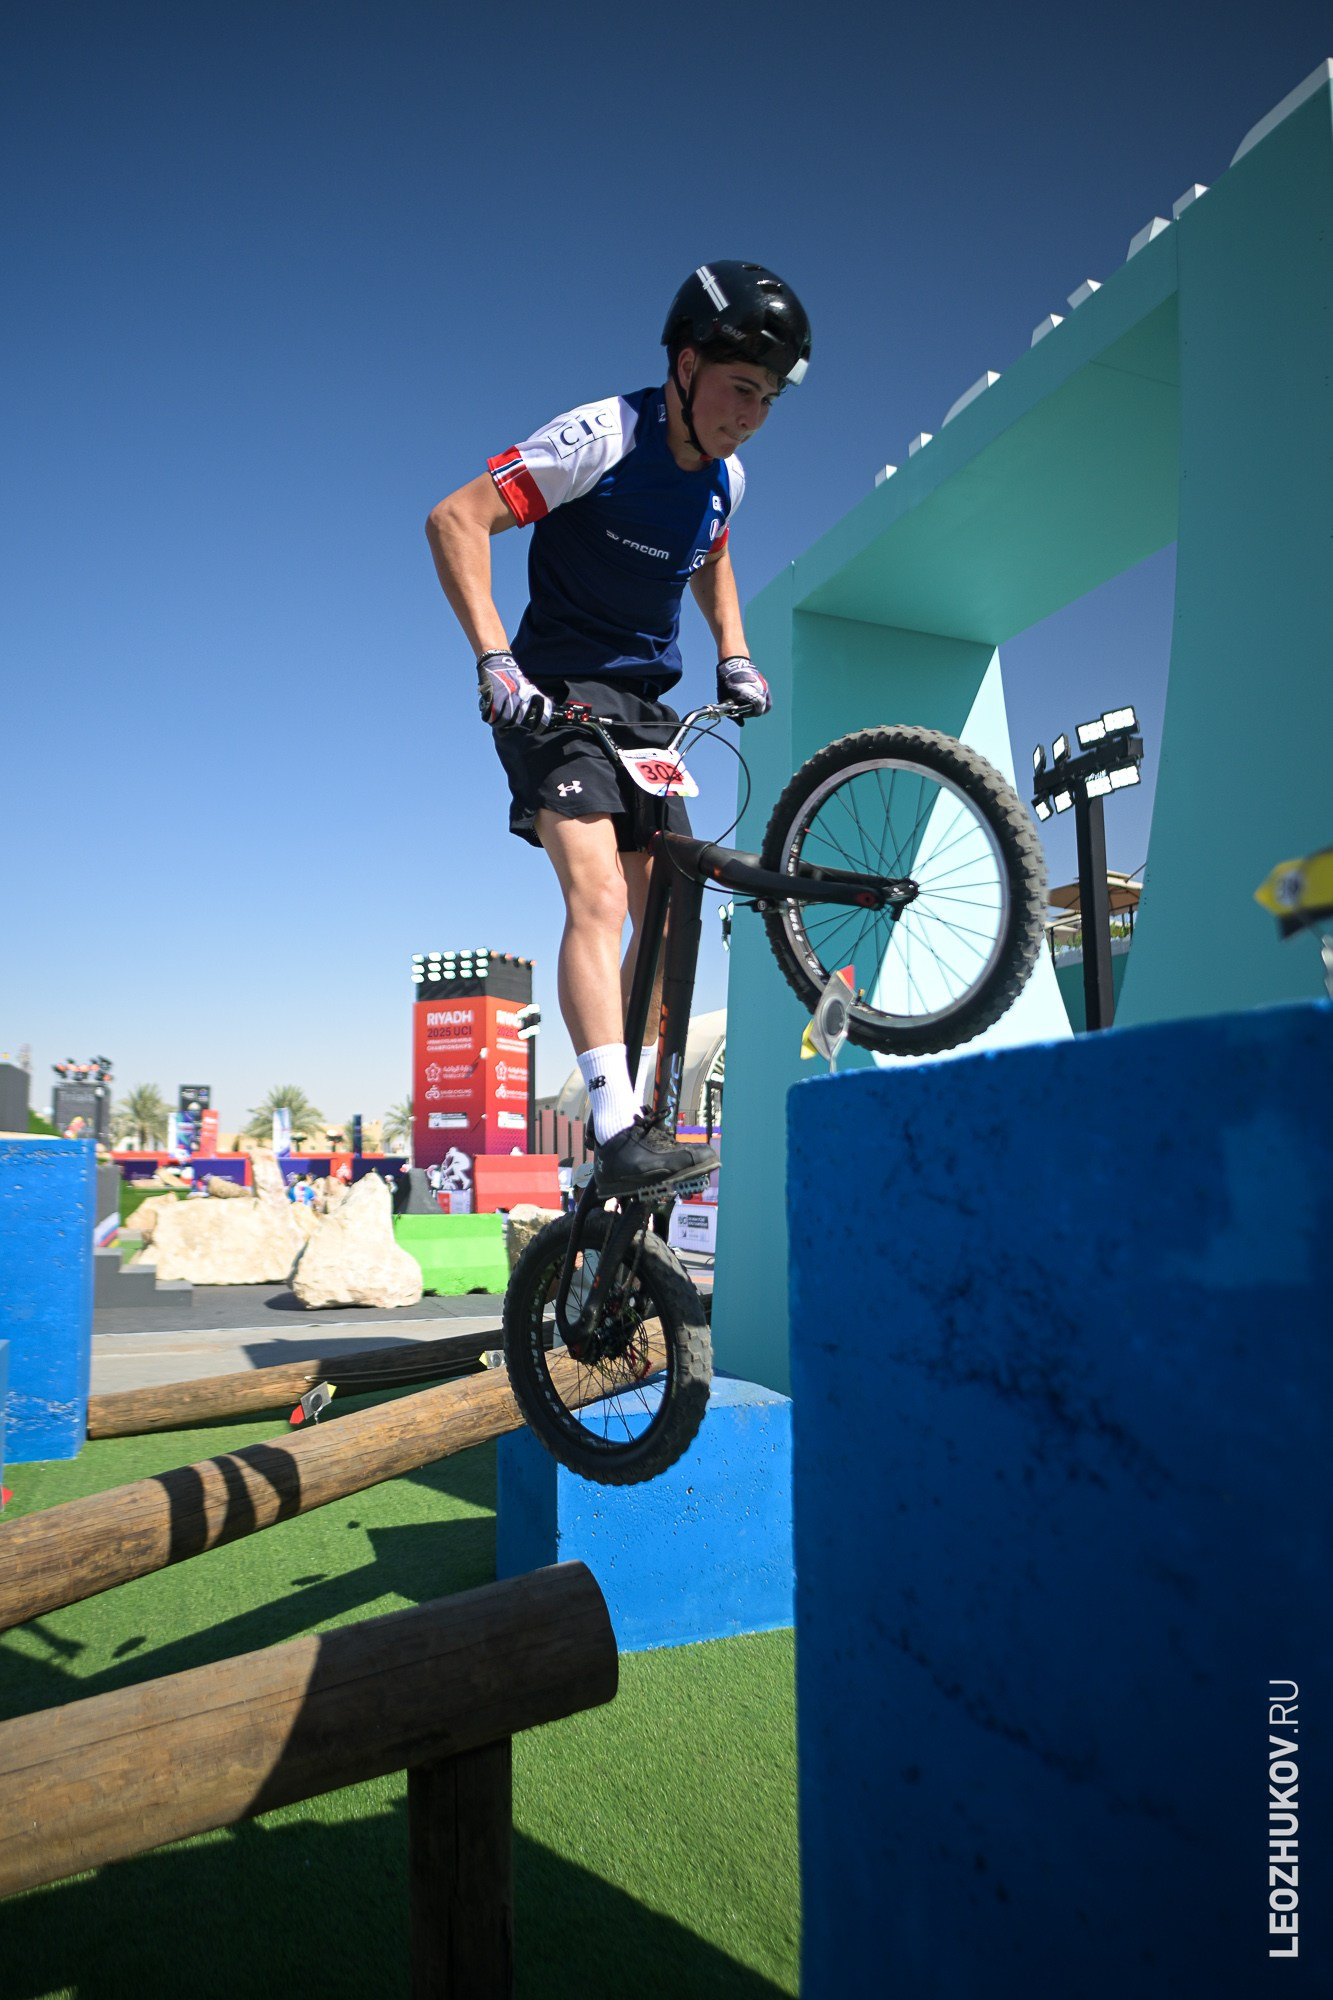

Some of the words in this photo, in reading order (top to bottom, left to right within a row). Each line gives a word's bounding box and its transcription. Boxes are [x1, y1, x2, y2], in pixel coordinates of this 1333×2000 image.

[560, 413, 613, 446] CIC
[622, 539, 670, 560] FACOM
[427, 1011, 473, 1026] RIYADH
[427, 1027, 451, 1038] 2025
[454, 1026, 472, 1037] UCI
